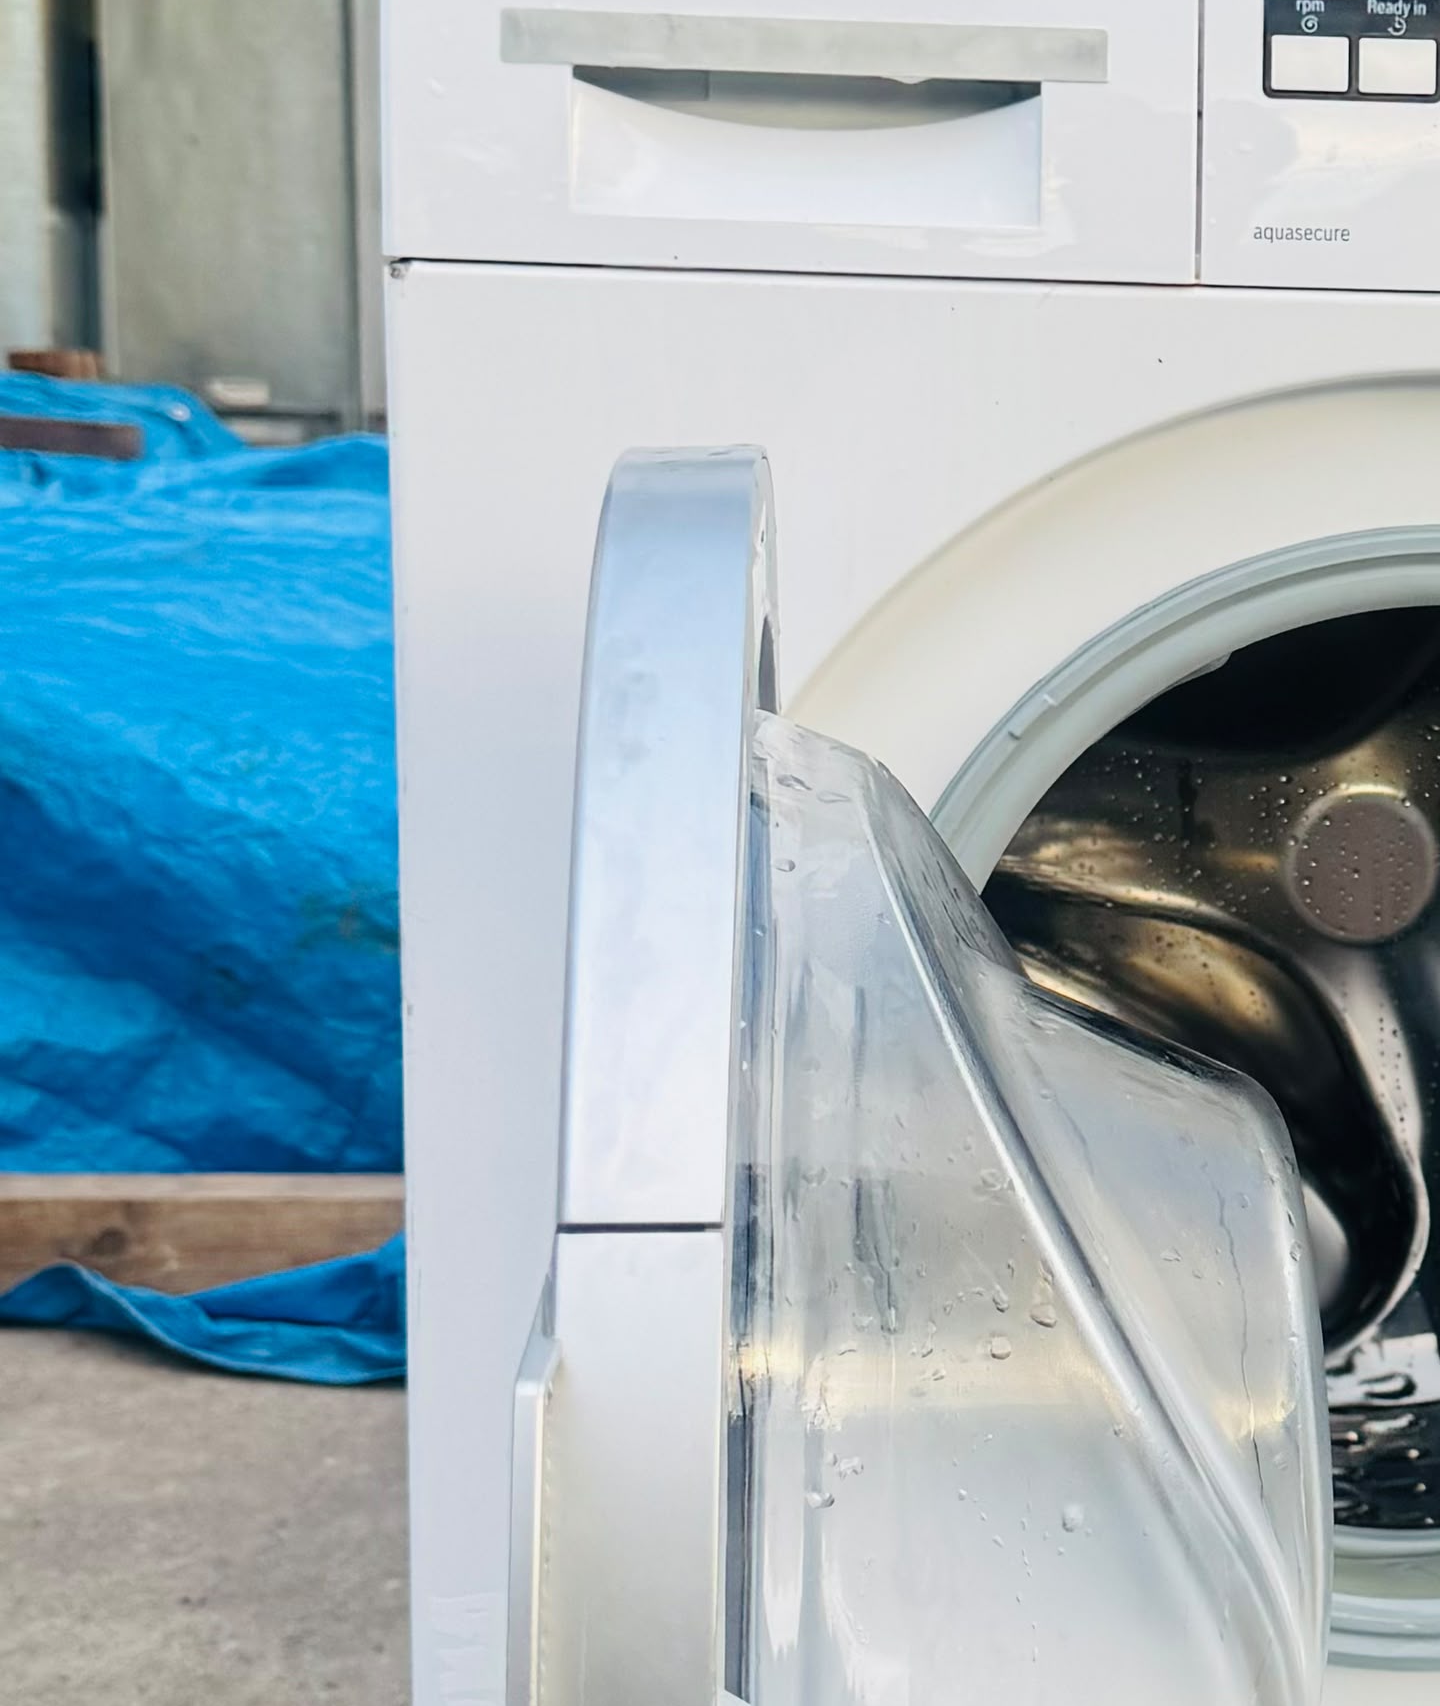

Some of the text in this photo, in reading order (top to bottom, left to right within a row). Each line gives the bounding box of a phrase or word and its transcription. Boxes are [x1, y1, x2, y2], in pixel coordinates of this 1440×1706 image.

[1296, 0, 1325, 15] rpm
[1413, 0, 1427, 15] in
[1253, 226, 1350, 243] aquasecure
